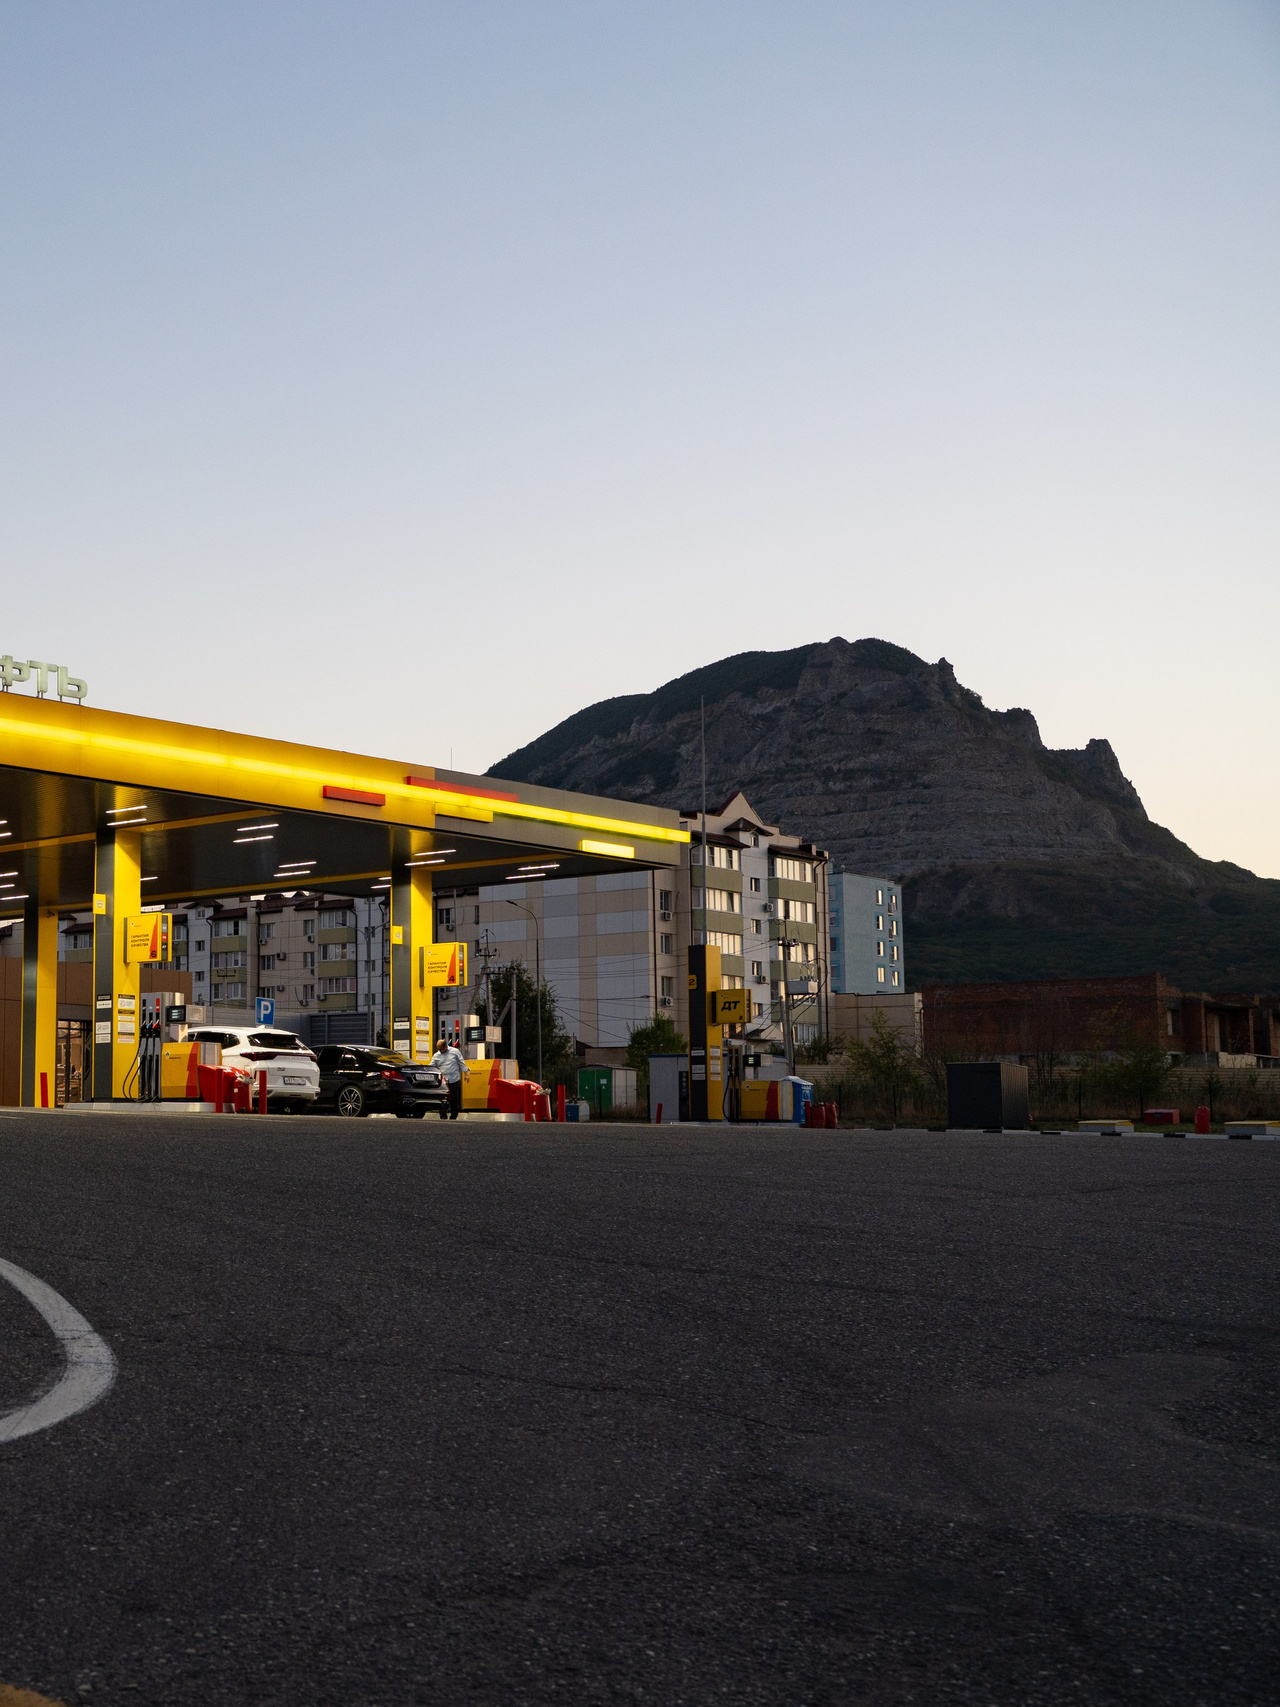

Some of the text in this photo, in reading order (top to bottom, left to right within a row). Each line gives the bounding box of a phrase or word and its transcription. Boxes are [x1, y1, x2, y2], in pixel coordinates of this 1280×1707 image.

[150, 950, 157, 958] 6
[689, 978, 695, 986] 2
[721, 1001, 740, 1011] ДТ
[260, 1001, 272, 1022] P
